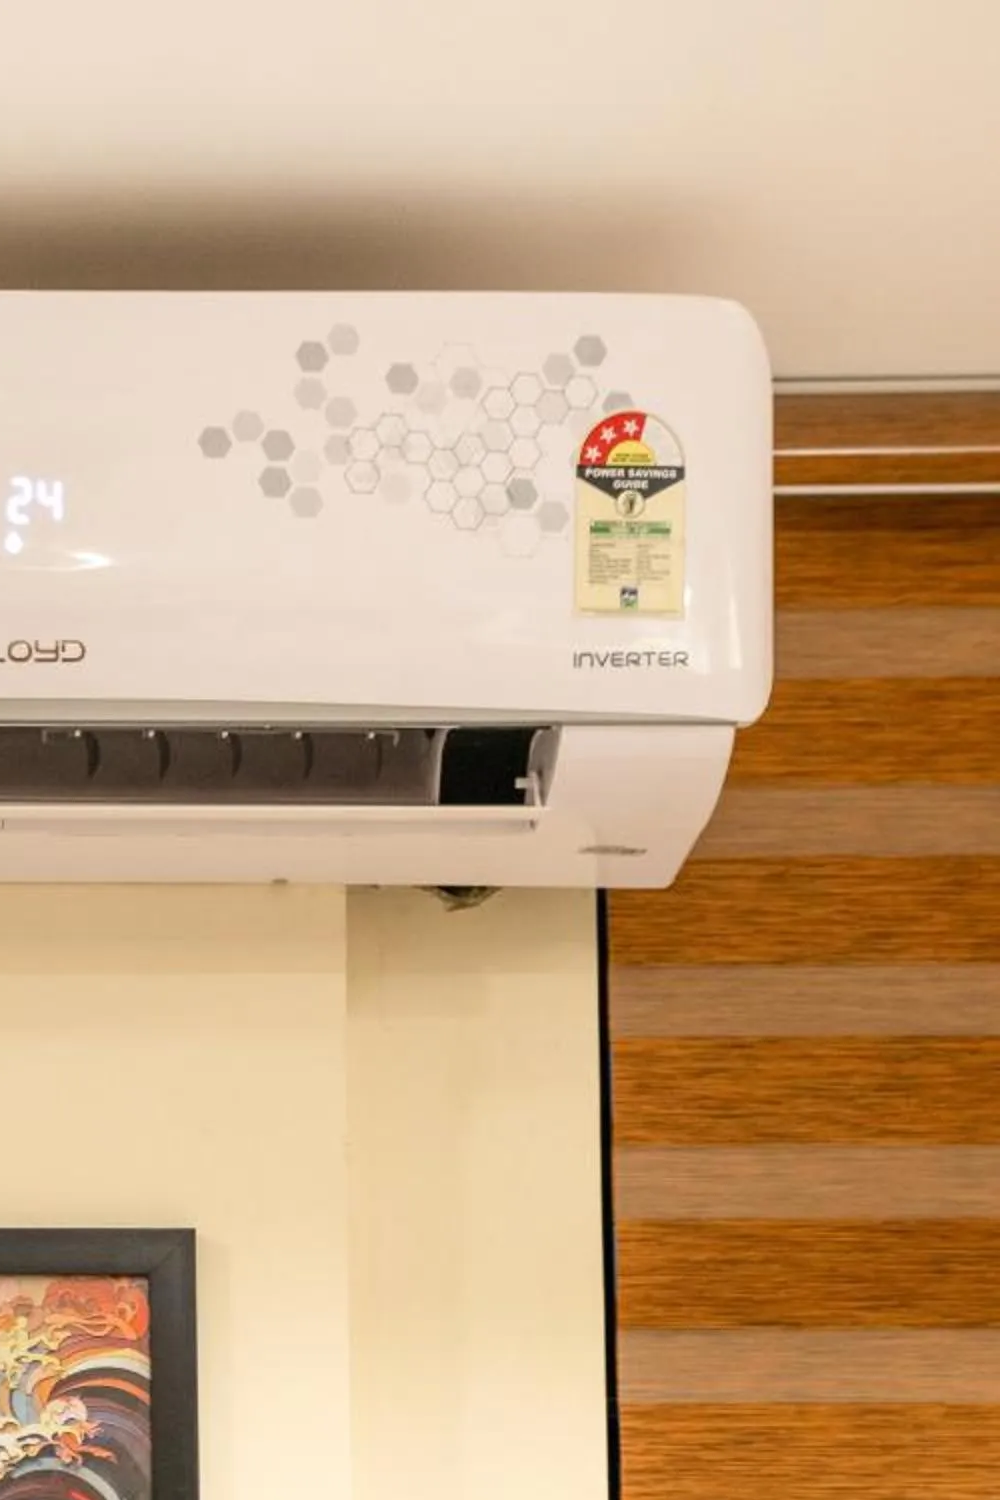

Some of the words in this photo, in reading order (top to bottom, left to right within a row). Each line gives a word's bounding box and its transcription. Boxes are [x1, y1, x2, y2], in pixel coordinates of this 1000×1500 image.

[585, 468, 625, 478] POWER
[627, 469, 677, 479] SAVINGS
[6, 475, 64, 524] 24
[573, 651, 689, 668] INVERTER
